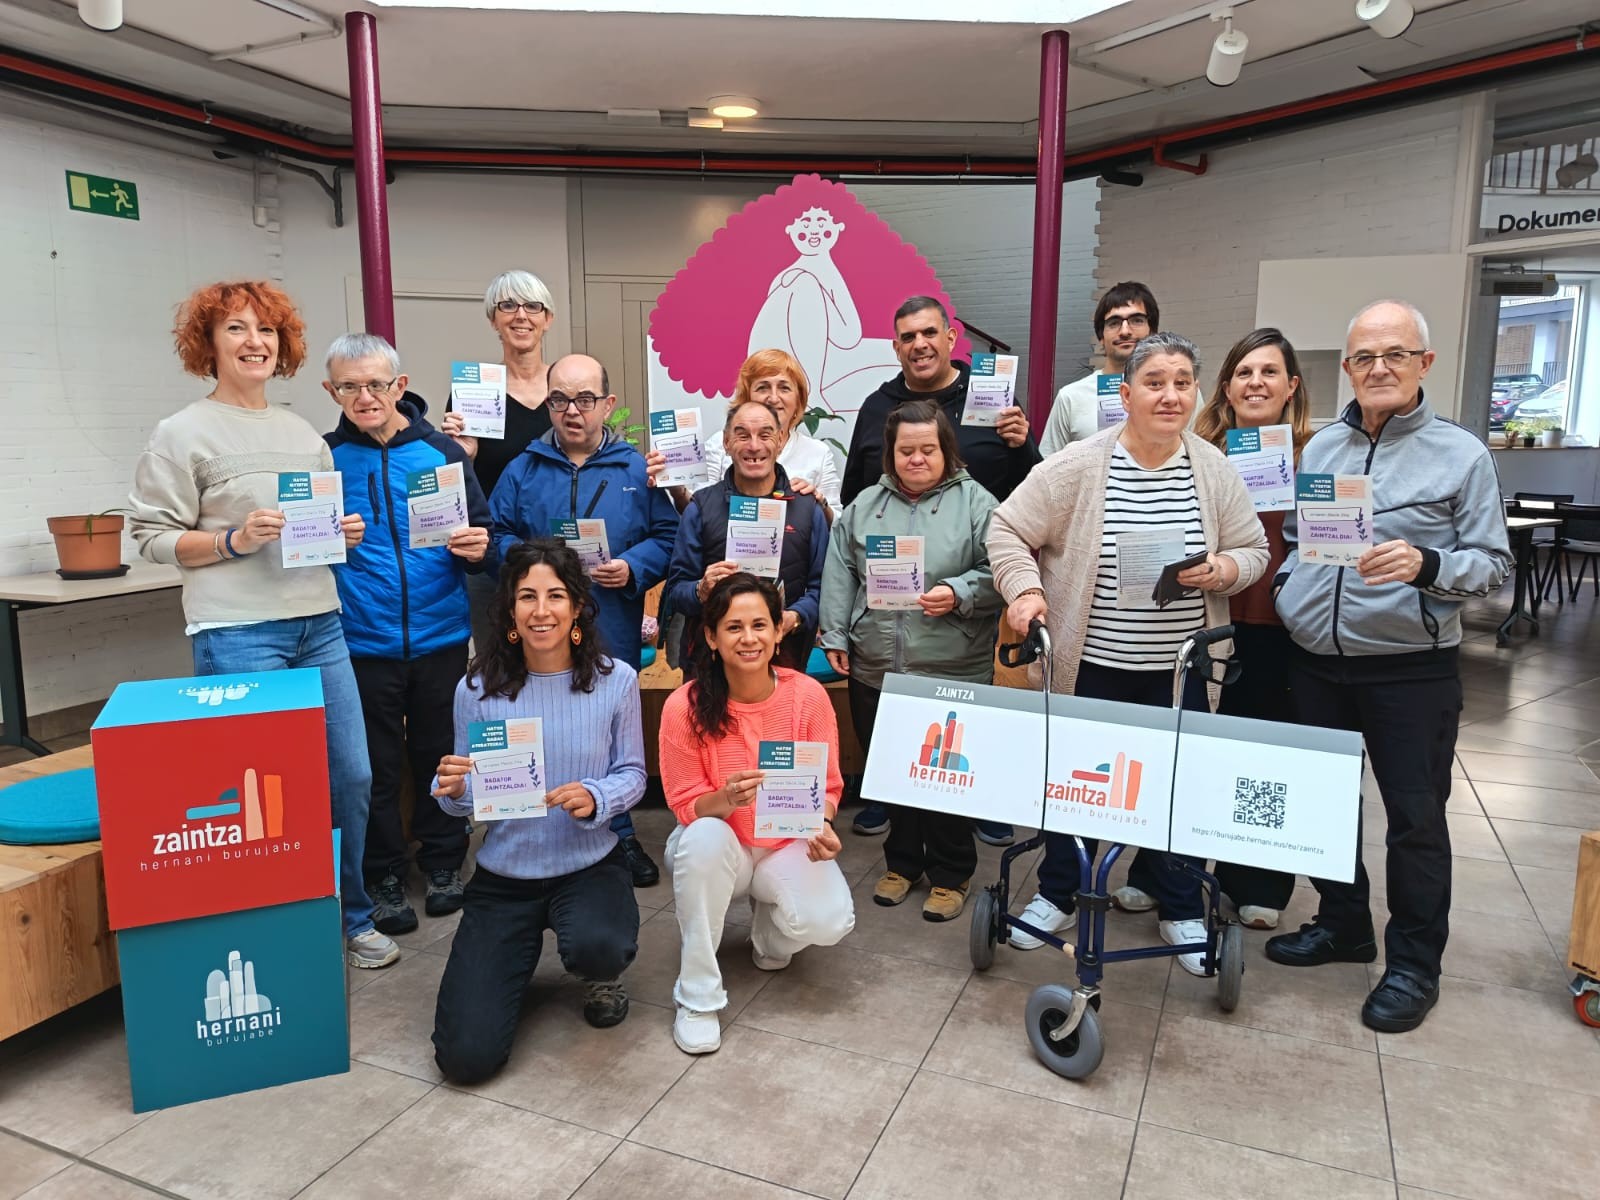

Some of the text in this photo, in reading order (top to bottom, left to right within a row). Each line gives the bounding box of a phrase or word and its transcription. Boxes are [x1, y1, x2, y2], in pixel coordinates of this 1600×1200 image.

[1498, 207, 1600, 234] Dokume
[936, 686, 975, 701] ZAINTZA
[484, 776, 512, 784] BADATOR
[909, 761, 975, 788] hernani
[914, 780, 966, 795] burujabe
[1046, 780, 1106, 807] zaintza
[1033, 800, 1148, 826] hrnani burujabe
[152, 822, 242, 855] zaintza
[1192, 826, 1325, 855] https://burujabe.hernani.eus/eu/zaintza
[140, 841, 301, 872] hernani burujabe
[196, 1006, 281, 1039] hernani
[206, 1028, 273, 1047] burujabe
